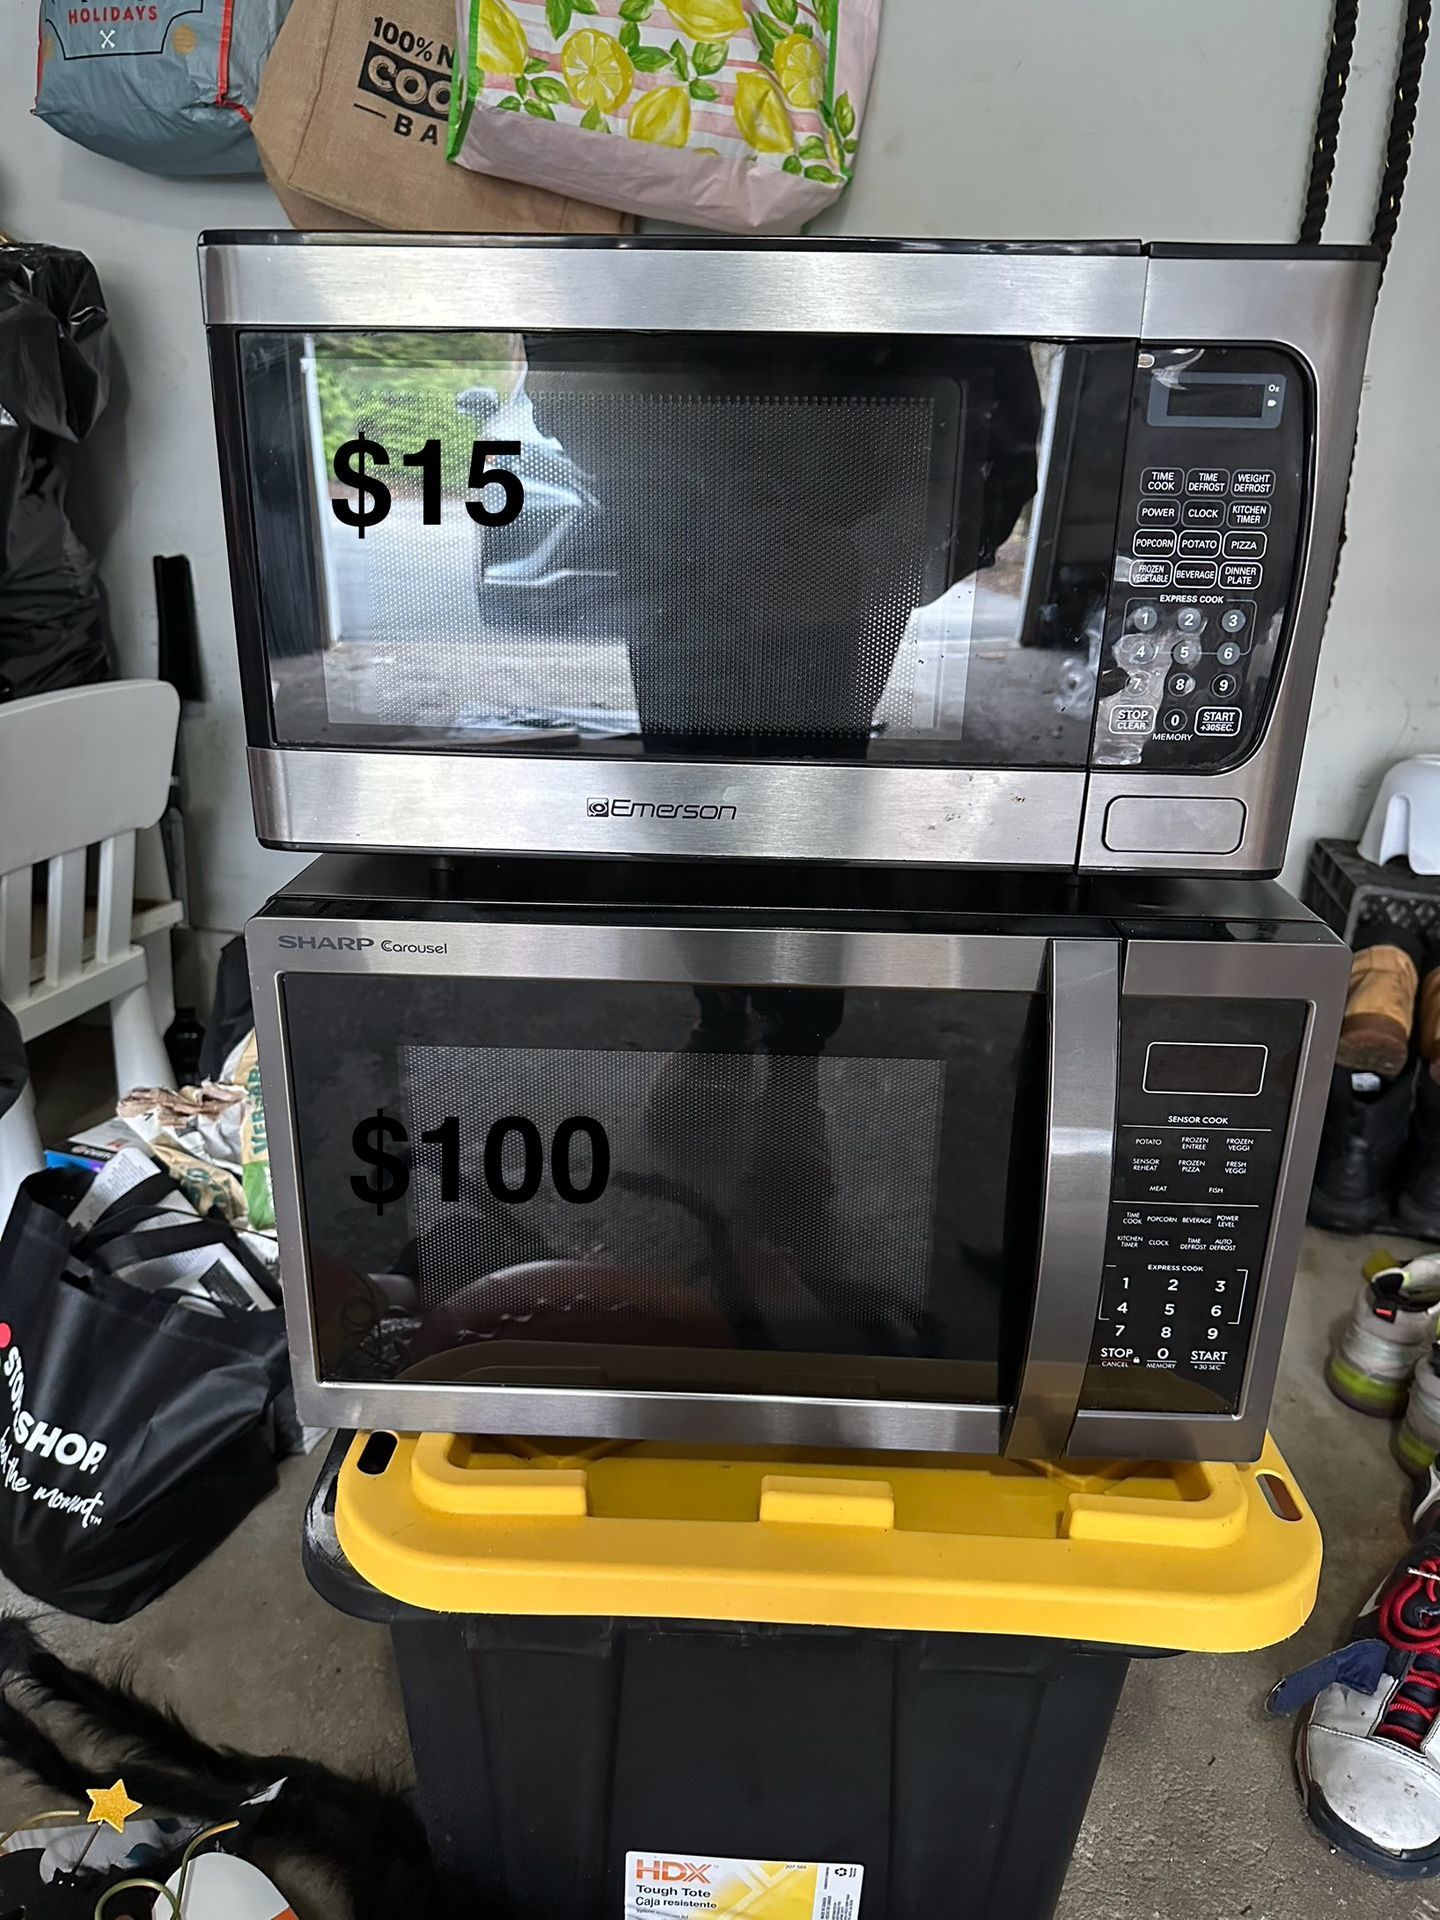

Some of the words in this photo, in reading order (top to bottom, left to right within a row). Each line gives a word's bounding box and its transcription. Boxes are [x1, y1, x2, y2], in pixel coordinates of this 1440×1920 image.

[68, 5, 158, 25] HOLIDAYS
[373, 16, 434, 62] 100%
[1152, 472, 1174, 480] TIME
[1199, 473, 1218, 481] TIME
[1238, 474, 1270, 483] WEIGHT
[1148, 482, 1175, 491] COOK
[1188, 483, 1225, 491] DEFROST
[1234, 483, 1271, 493] DEFROST
[1142, 508, 1175, 517] POWER
[1188, 509, 1218, 518] CLOCK
[1233, 506, 1266, 514] KITCHEN
[1237, 515, 1261, 523] TIMER
[1136, 539, 1174, 548] POPCORN
[1182, 540, 1217, 548] POTATO
[1231, 541, 1257, 550] PIZZA
[1139, 565, 1164, 574] FROZEN
[1225, 567, 1257, 576] DINNER
[1132, 574, 1169, 583] VEGETABLE
[1176, 571, 1214, 579] BEVERAGE
[1227, 576, 1252, 584] PLATE
[1160, 595, 1197, 603] EXPRESS
[1142, 613, 1148, 624] 1
[1185, 615, 1194, 625] 2
[1229, 616, 1237, 626] 3
[1136, 647, 1145, 656] 4
[1180, 647, 1188, 657] 5
[1224, 648, 1233, 658] 6
[1132, 679, 1141, 689] 7
[1176, 680, 1185, 690] 8
[1219, 680, 1229, 691] 9
[1118, 711, 1148, 719] STOP
[1203, 712, 1235, 721] START
[1118, 722, 1146, 730] CLEAR
[611, 799, 737, 820] Emerson
[278, 935, 375, 951] SHARP
[380, 939, 447, 955] Carousel
[1168, 1116, 1200, 1124] SENSOR
[1123, 1277, 1129, 1289] 1
[1168, 1279, 1178, 1291] 2
[1215, 1281, 1226, 1292] 3
[1117, 1303, 1127, 1313] 4
[1165, 1304, 1175, 1315] 5
[1211, 1305, 1221, 1316] 6
[1115, 1325, 1125, 1336] 7
[1161, 1327, 1171, 1338] 8
[1208, 1328, 1218, 1339] 9
[1101, 1348, 1133, 1358] STOP
[1191, 1351, 1228, 1361] START
[5, 1456, 31, 1492] the
[636, 1859, 712, 1884] HDX
[636, 1884, 678, 1896] Tough
[682, 1887, 711, 1898] Tote
[635, 1896, 661, 1908] Caja
[663, 1899, 717, 1909] resistente
